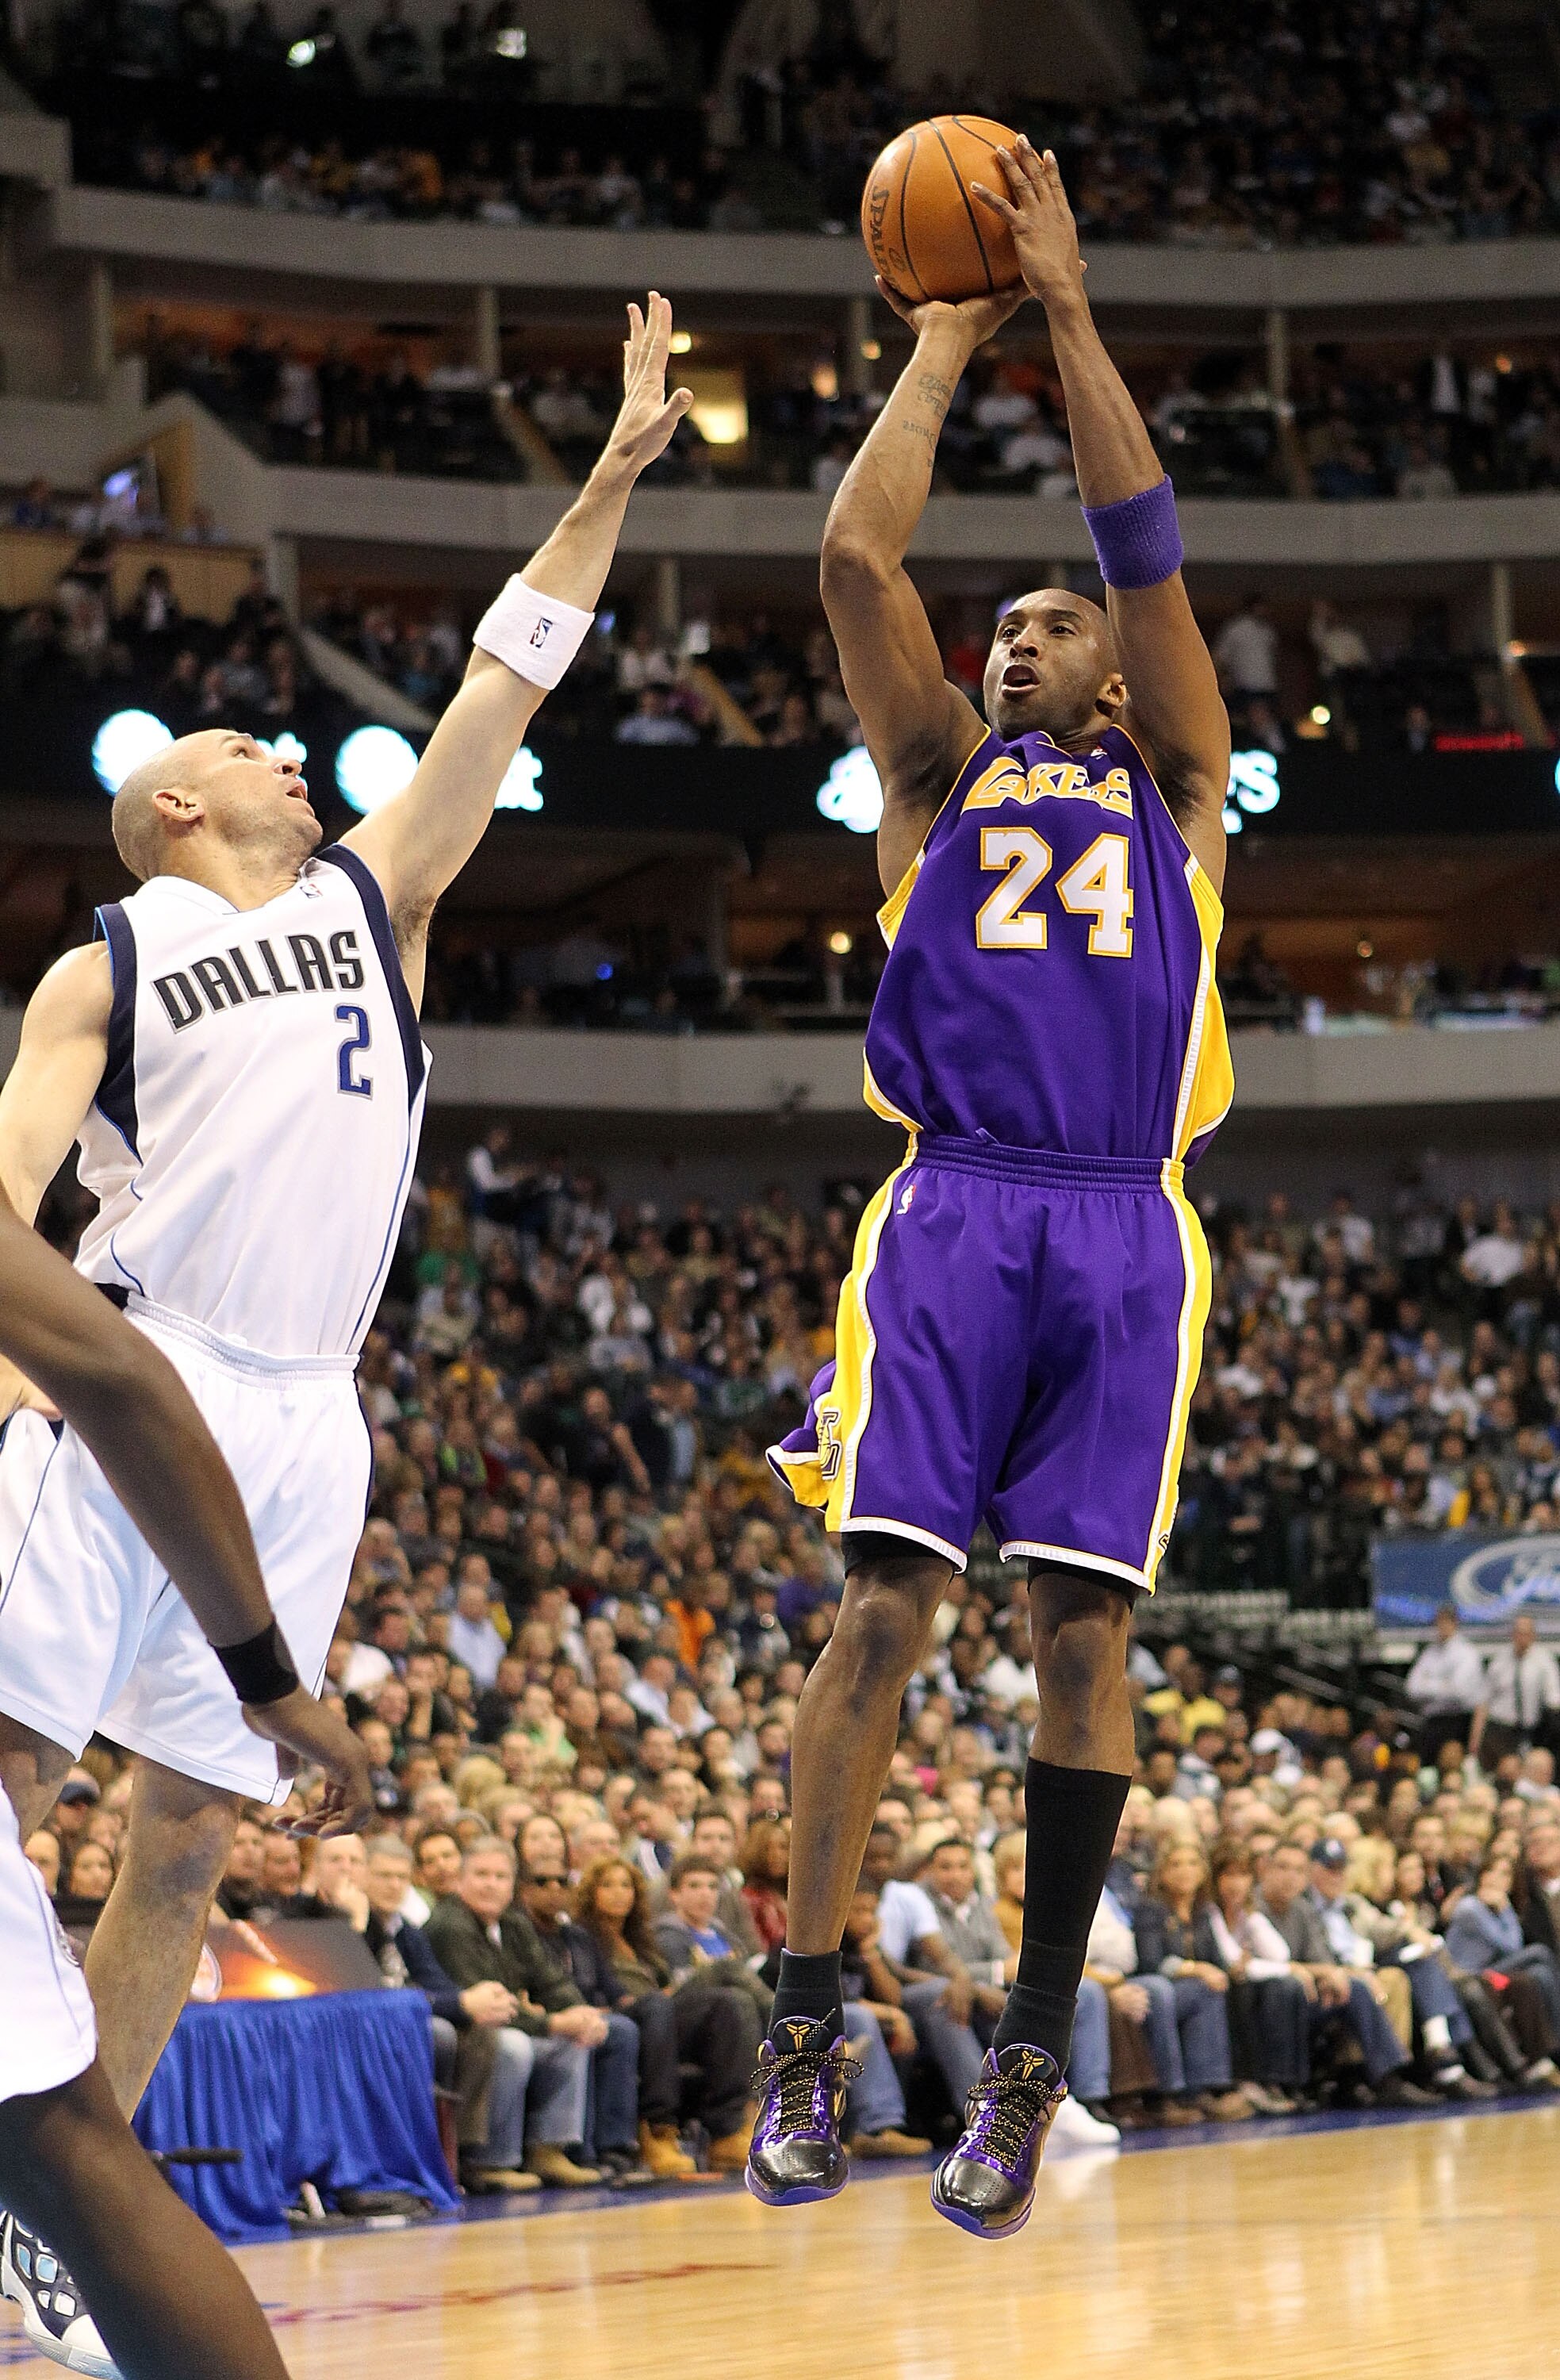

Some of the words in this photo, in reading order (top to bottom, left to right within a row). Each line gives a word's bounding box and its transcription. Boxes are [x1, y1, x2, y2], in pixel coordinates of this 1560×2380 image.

[870, 185, 899, 288] SPALD
[975, 826, 1134, 958] 24
[150, 929, 366, 1034] DALLAS
[335, 1003, 373, 1100] 2
